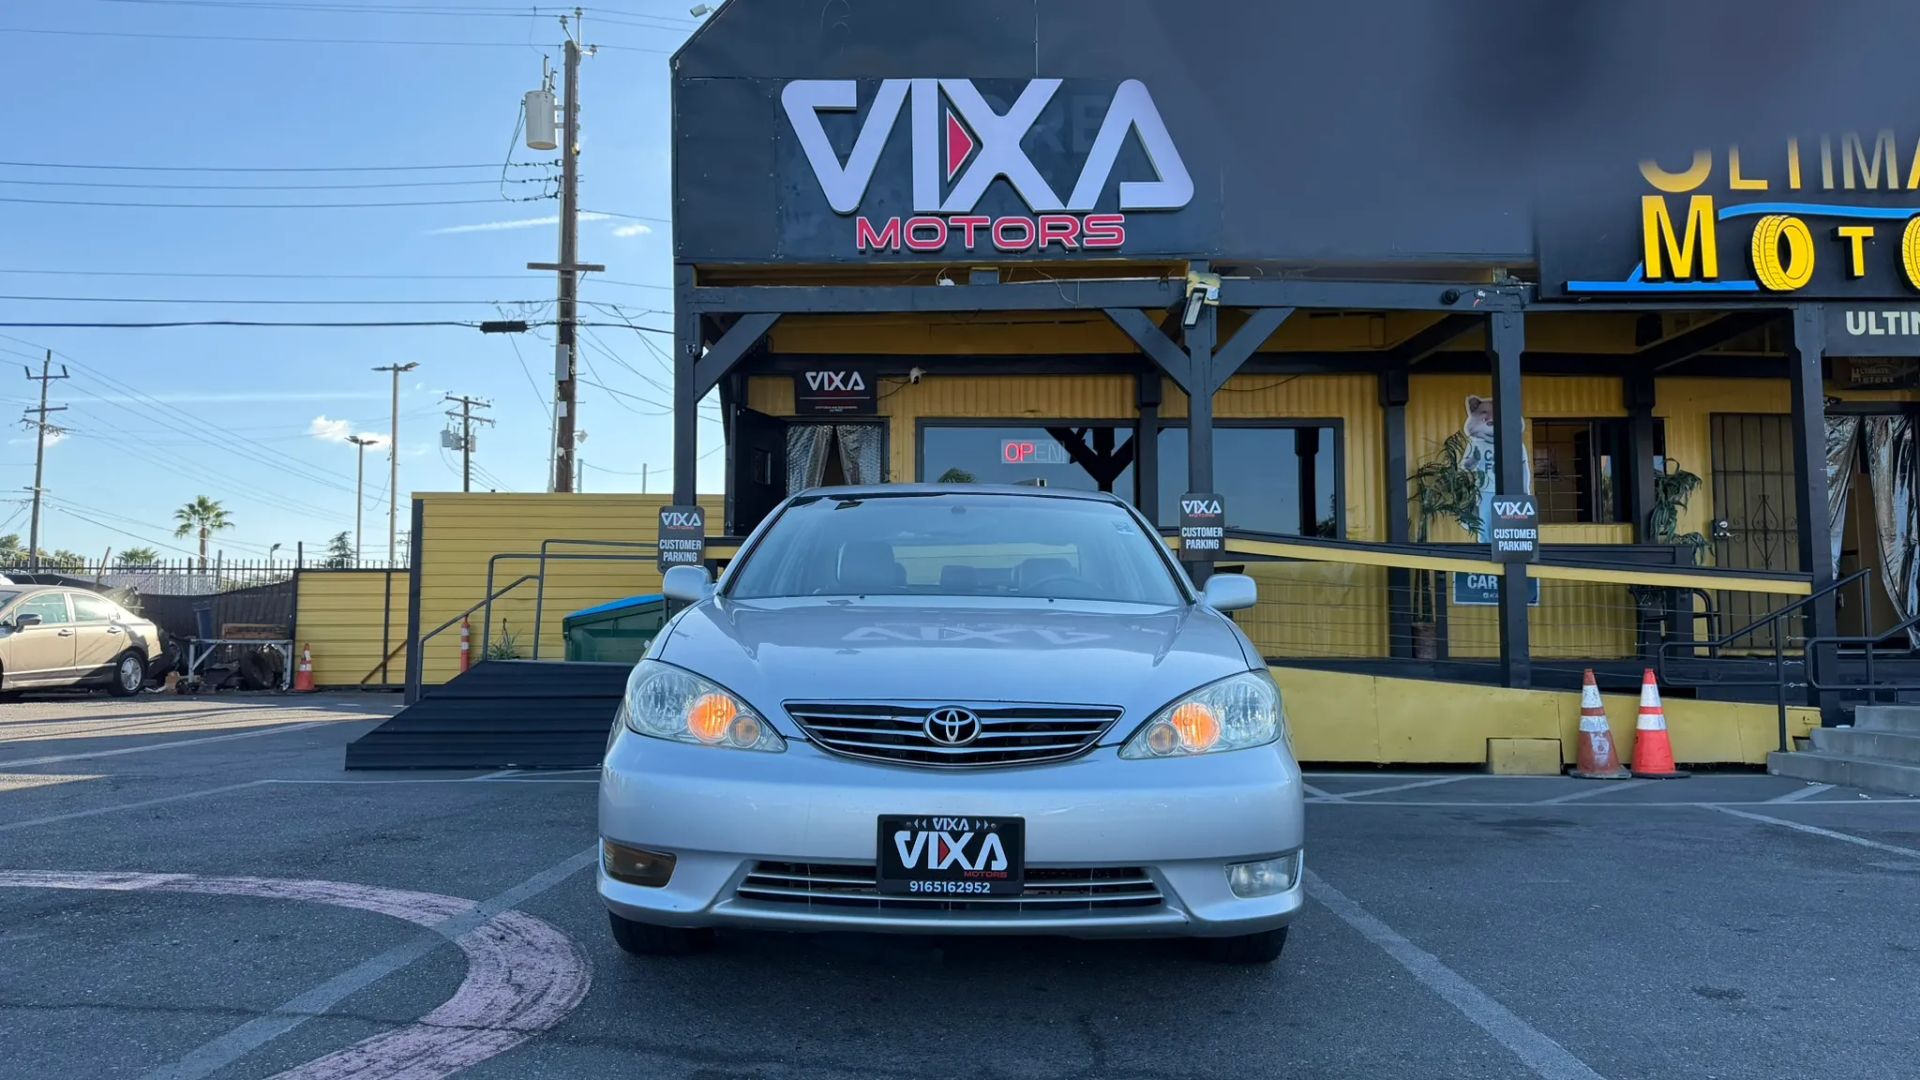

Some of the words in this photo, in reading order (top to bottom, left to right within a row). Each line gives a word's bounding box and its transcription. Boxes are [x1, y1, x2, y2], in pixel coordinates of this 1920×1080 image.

[781, 78, 1194, 214] VIXA
[856, 213, 1126, 250] MOTORS
[805, 371, 865, 391] VIXA
[1004, 442, 1062, 463] OPEN
[1181, 500, 1223, 514] VIXA
[1493, 501, 1535, 516] VIXA
[661, 512, 702, 527] VIXA
[1181, 527, 1223, 537] CUSTOMER
[1494, 528, 1537, 539] CUSTOMER
[660, 539, 702, 551] CUSTOMER
[1185, 539, 1219, 550] PARKING
[1498, 540, 1533, 551] PARKING
[663, 551, 698, 562] PARKING
[932, 817, 970, 831] VIXA
[894, 830, 1008, 871] VIXA
[964, 870, 1008, 878] MOTORS
[910, 881, 990, 893] 9165162952
